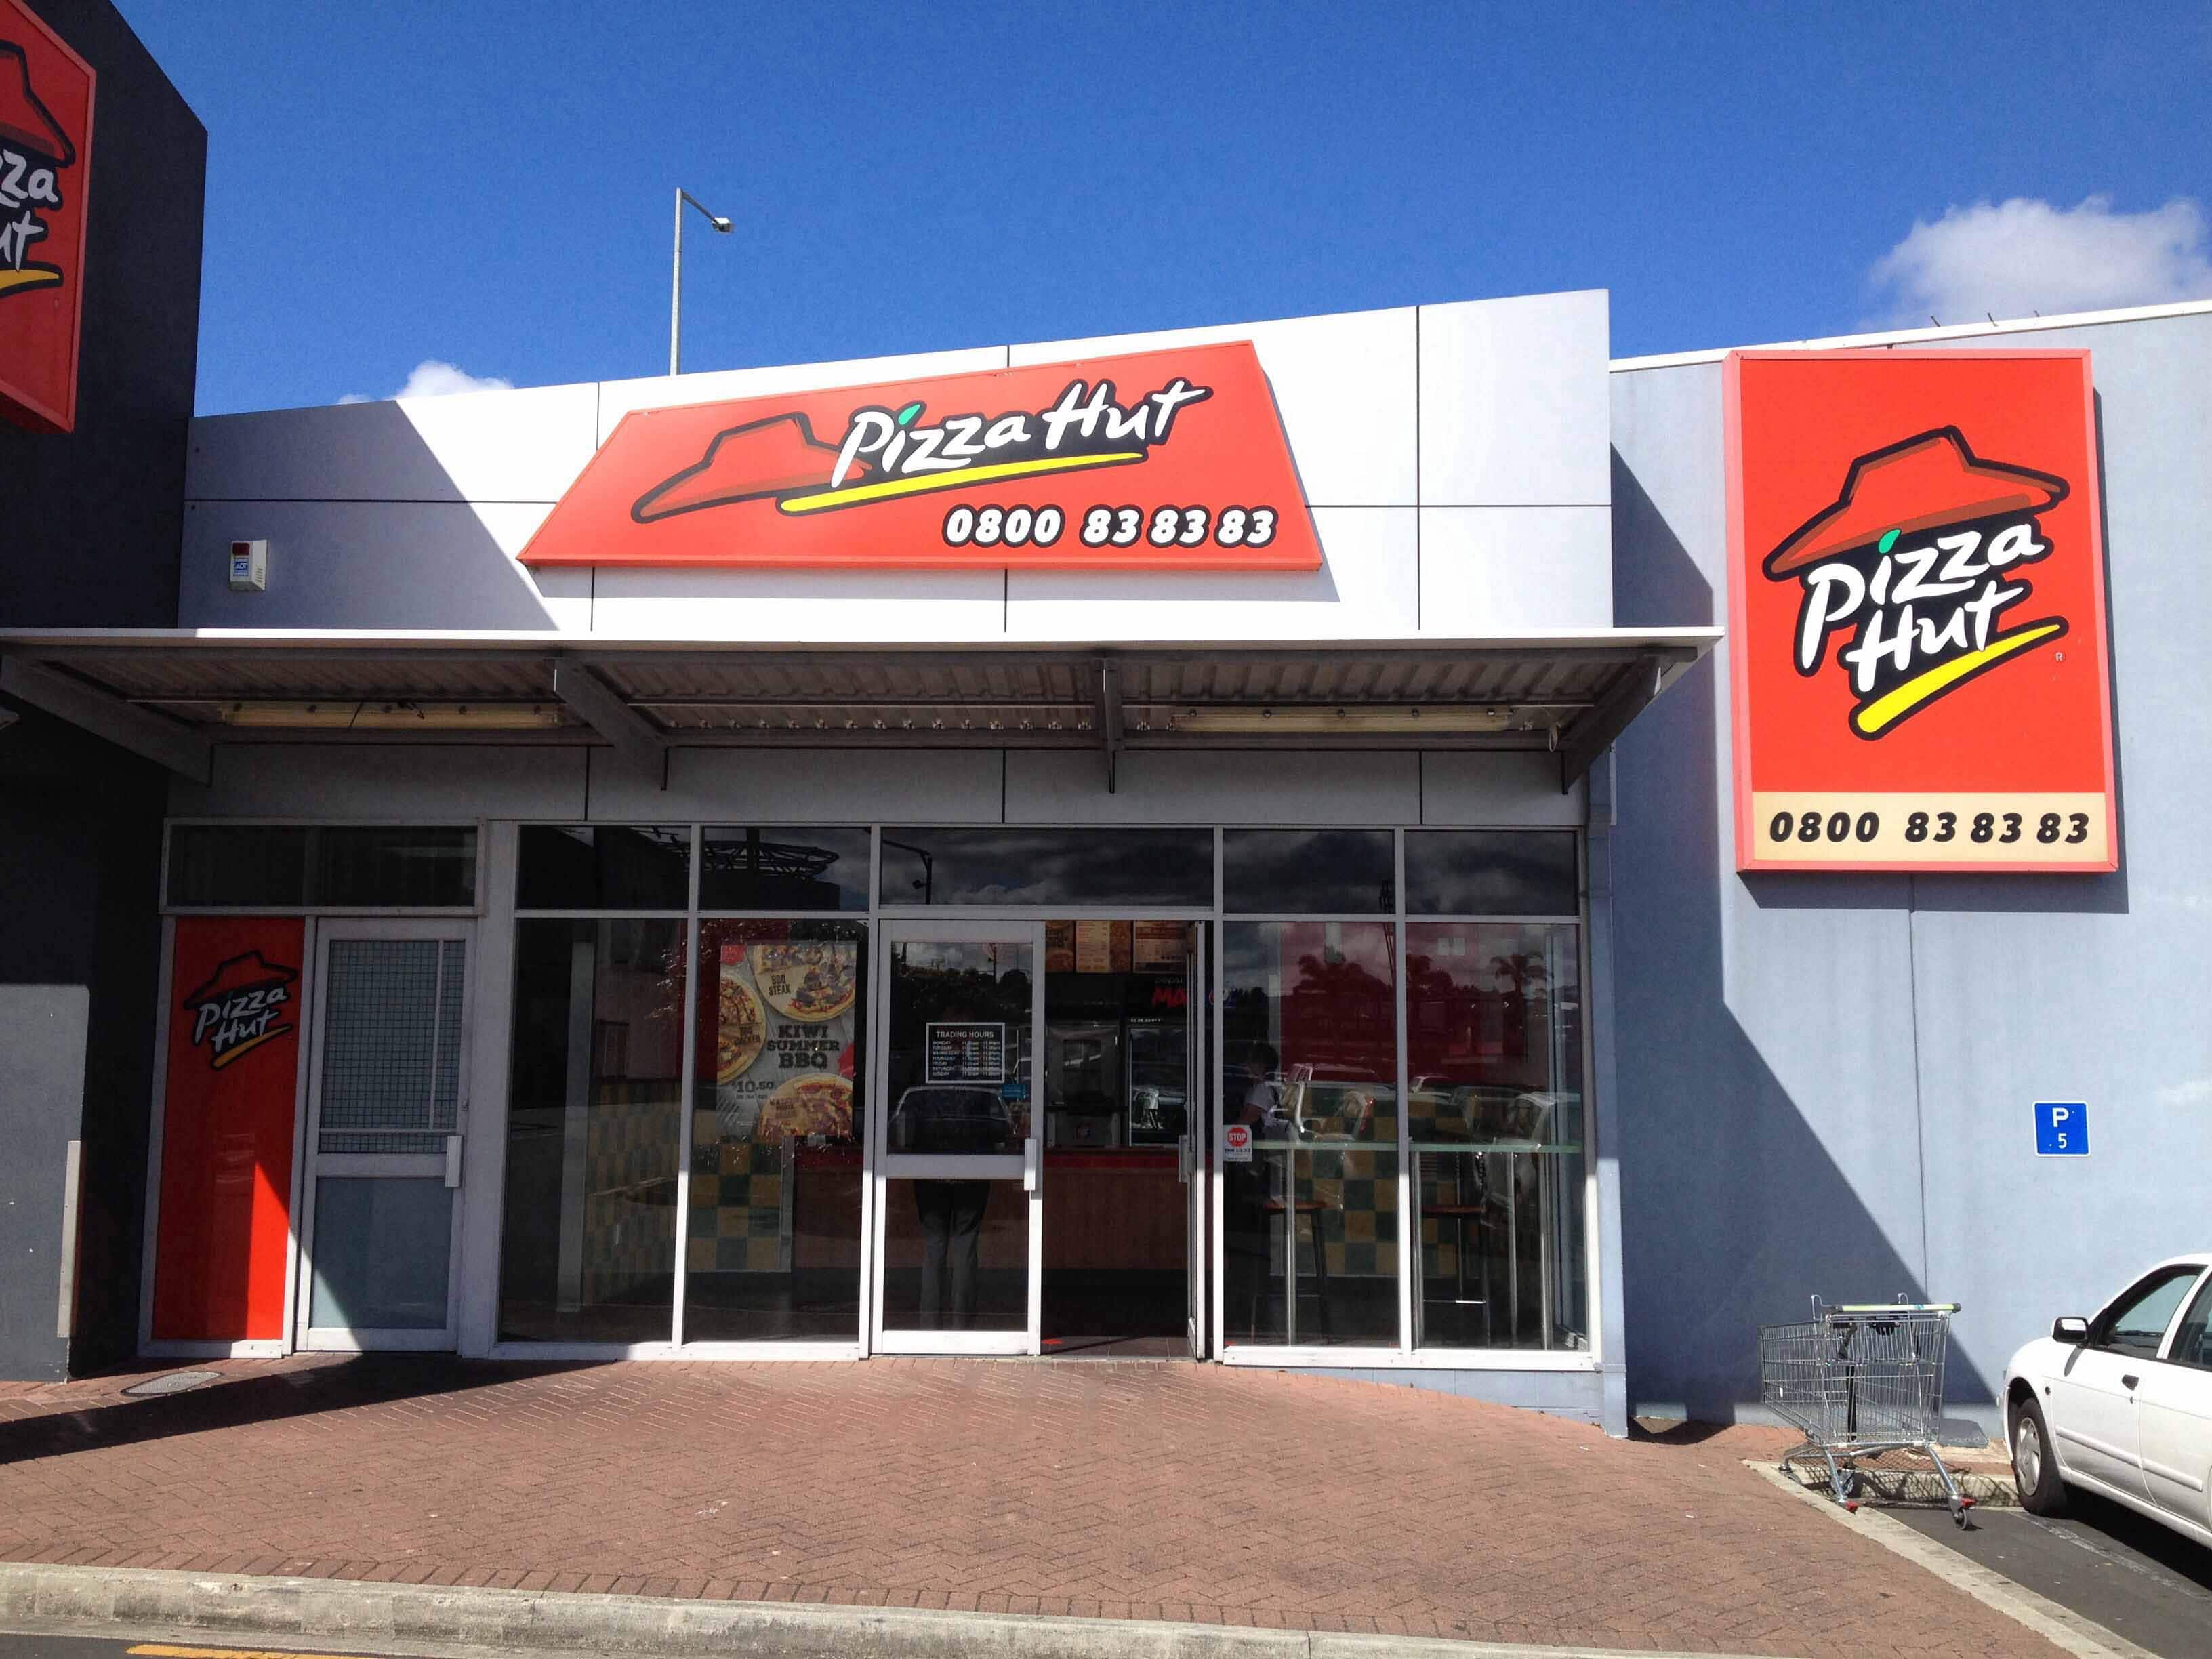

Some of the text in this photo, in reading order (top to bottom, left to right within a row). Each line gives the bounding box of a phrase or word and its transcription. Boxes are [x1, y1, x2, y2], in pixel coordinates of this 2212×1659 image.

[831, 380, 1206, 488] Pizza Hut
[947, 508, 1274, 544] 0800 83 83 83
[1802, 523, 2045, 669] Pizza
[1847, 580, 2024, 692] Hut
[1769, 811, 2089, 844] 0800 83 83 83
[769, 985, 791, 996] STEAK
[195, 987, 288, 1044] Pizza
[212, 1009, 279, 1052] Hut
[778, 1025, 829, 1038] KIWI
[767, 1040, 840, 1051] SUMMER
[779, 1053, 828, 1069] BBQ
[2052, 1107, 2069, 1128] P
[1229, 1133, 1247, 1142] STOP
[2058, 1132, 2068, 1149] 5
